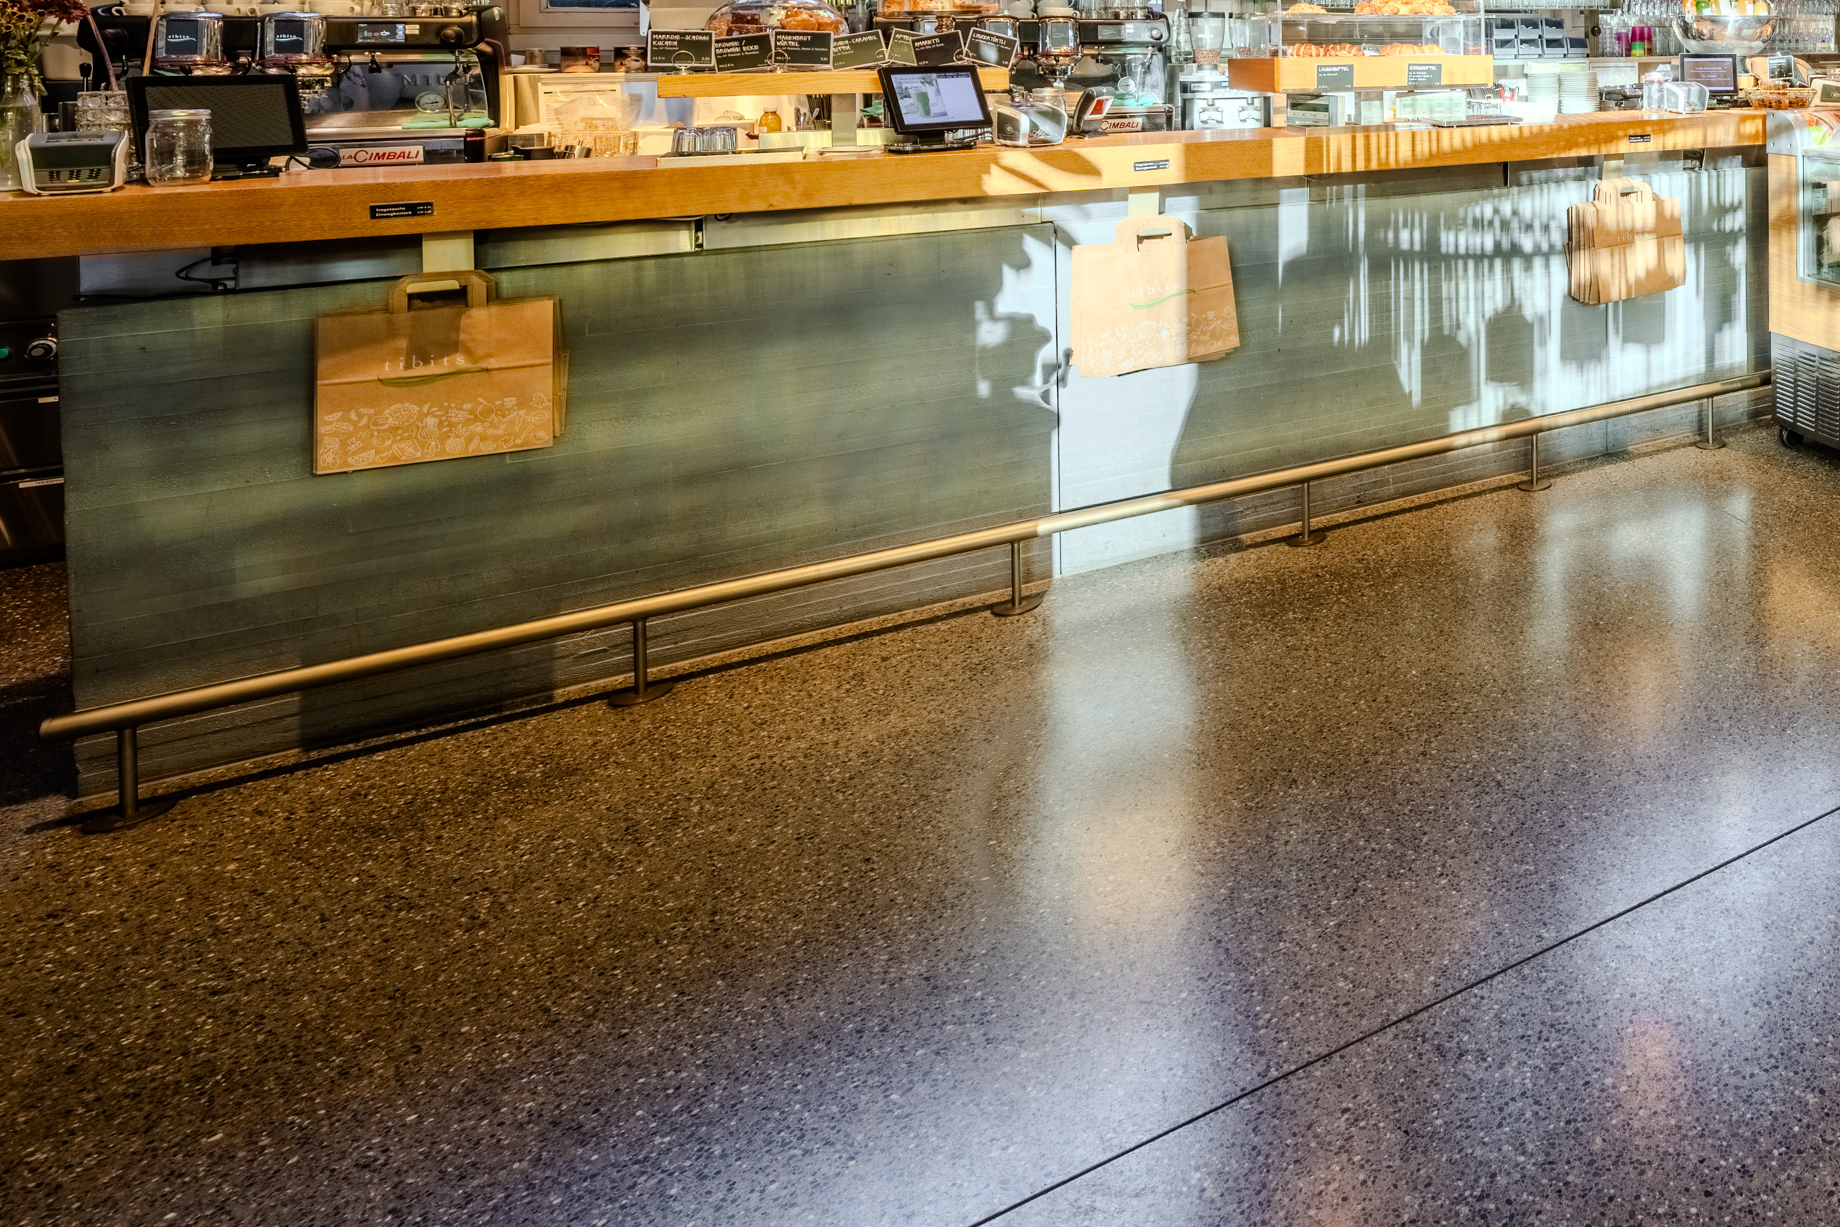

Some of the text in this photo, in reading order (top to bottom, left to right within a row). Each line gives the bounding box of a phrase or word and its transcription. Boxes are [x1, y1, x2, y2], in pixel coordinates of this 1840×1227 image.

[1100, 120, 1140, 131] CIMBALI
[354, 150, 420, 163] CIMBALI
[1617, 230, 1649, 242] tibits
[1130, 282, 1180, 298] tibits
[384, 354, 465, 372] tibits
